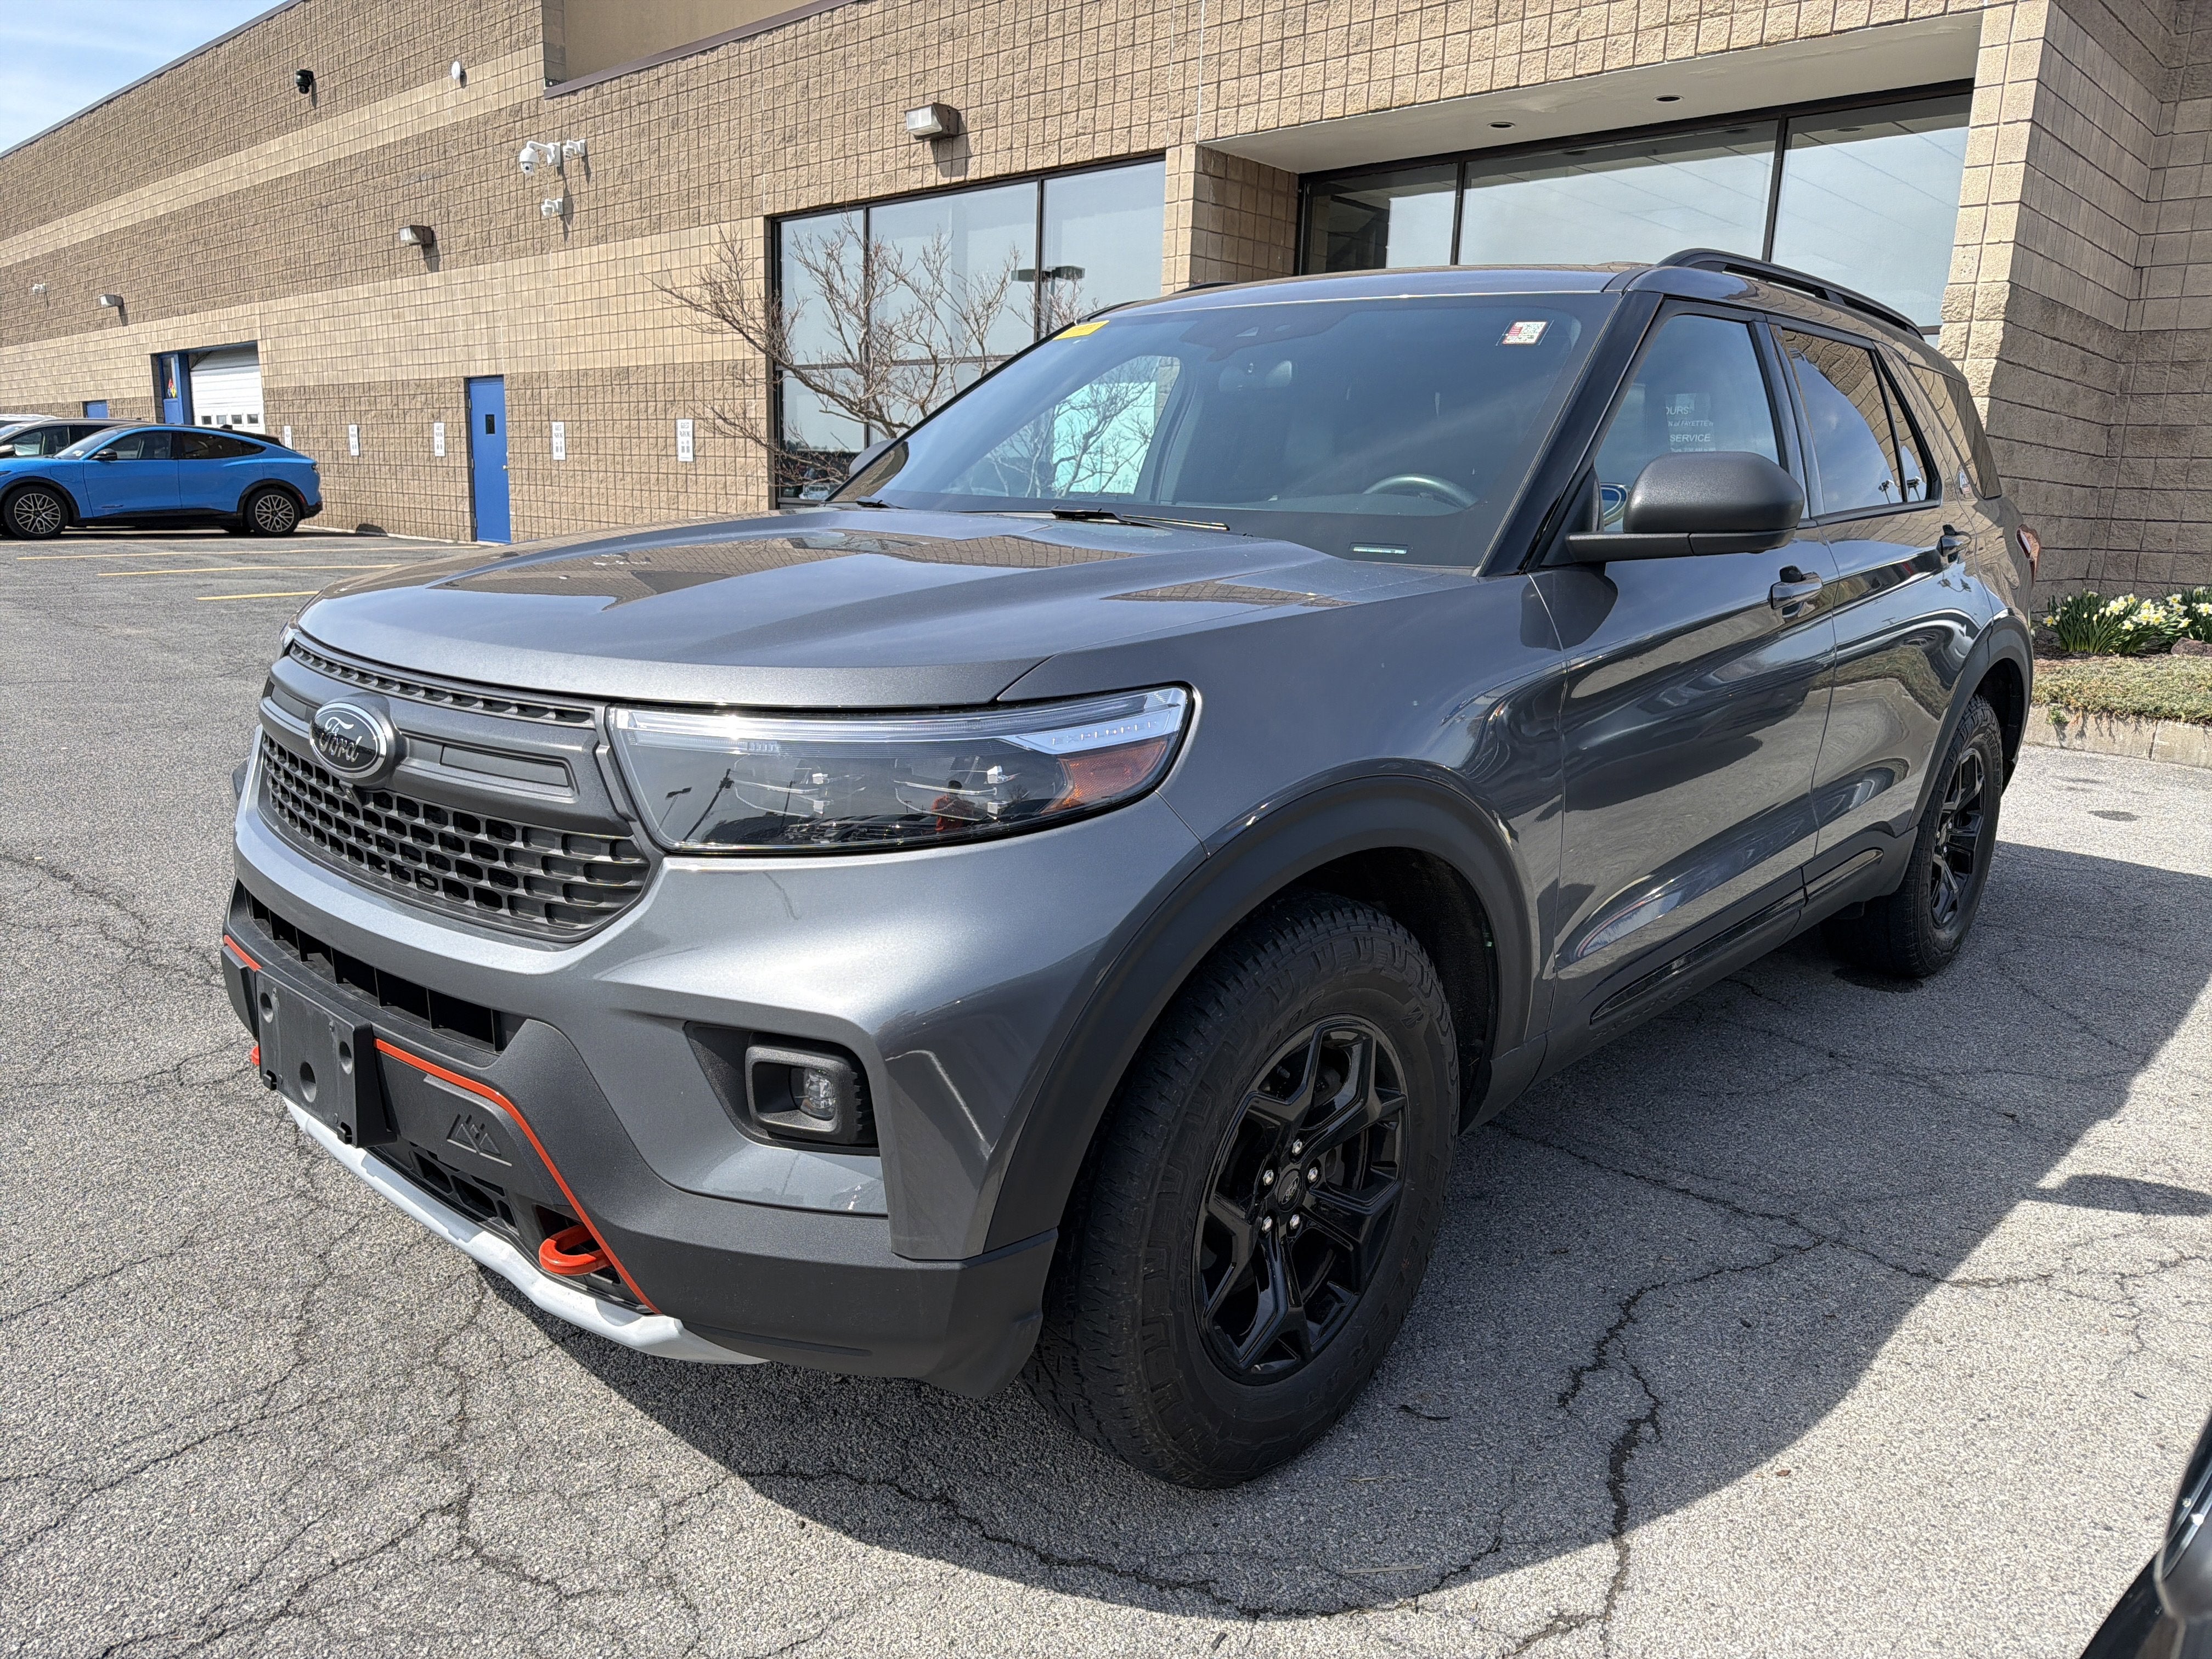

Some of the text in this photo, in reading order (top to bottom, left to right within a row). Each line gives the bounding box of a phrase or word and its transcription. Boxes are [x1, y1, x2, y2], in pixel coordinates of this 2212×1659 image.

[1669, 433, 1711, 442] SERVICE
[319, 716, 362, 763] Ford
[1052, 720, 1159, 746] EXPLORER
